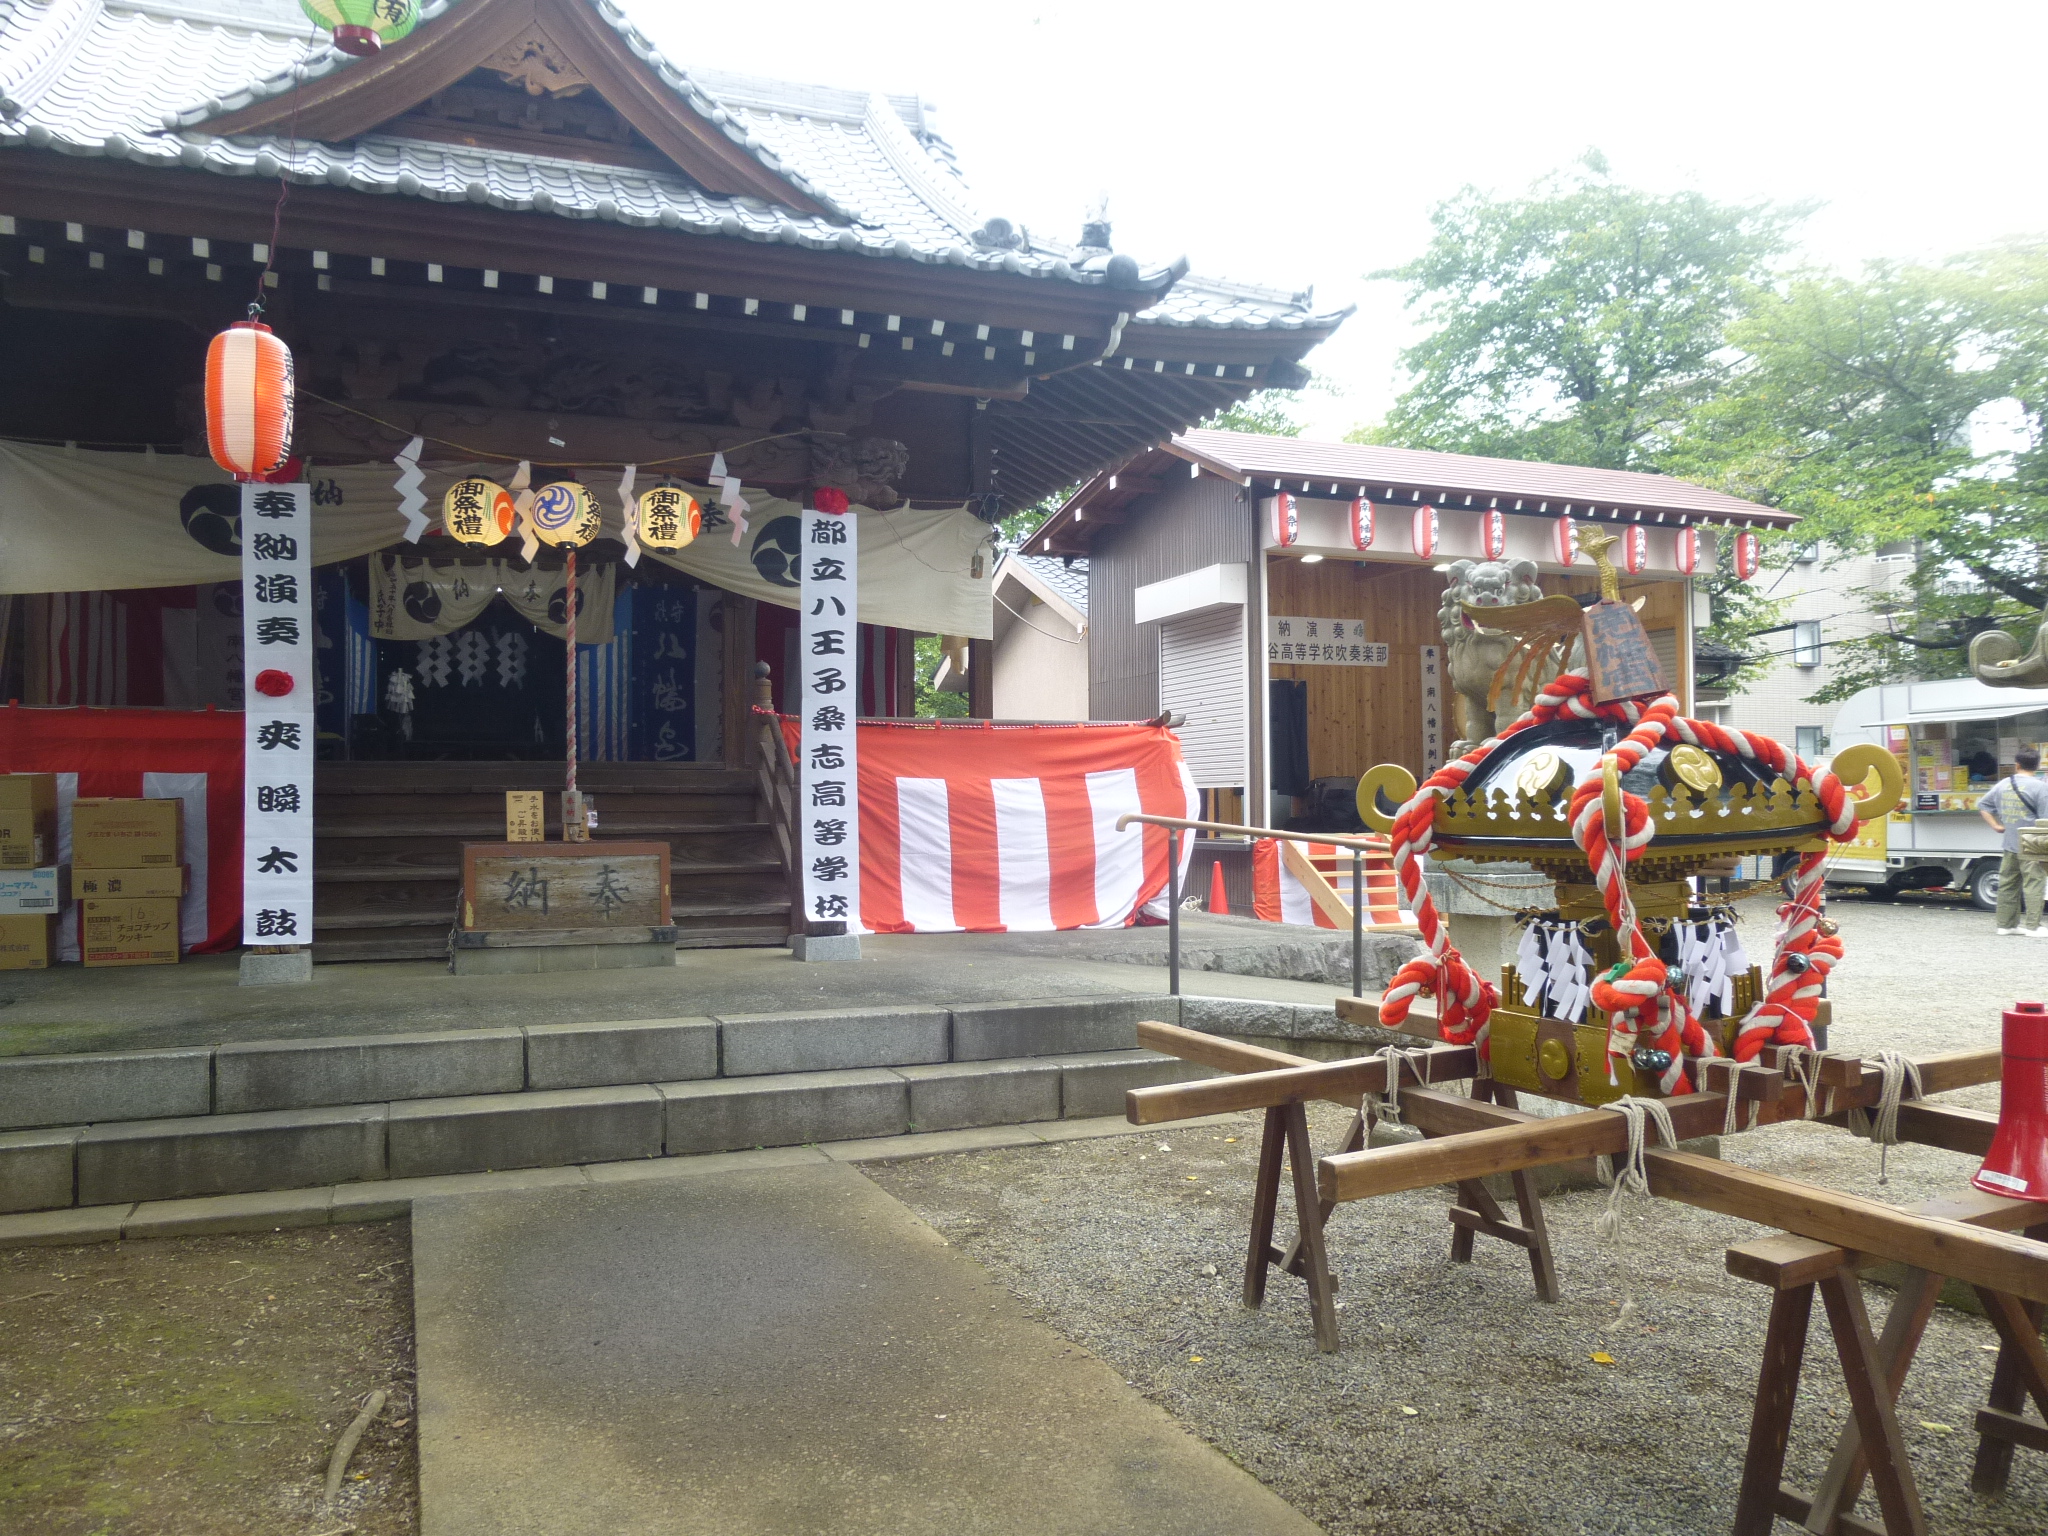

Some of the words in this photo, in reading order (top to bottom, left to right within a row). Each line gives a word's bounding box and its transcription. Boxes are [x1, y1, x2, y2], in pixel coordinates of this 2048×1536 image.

[450, 481, 485, 536] 御祭禮
[647, 490, 680, 541] 御祭禮
[1359, 502, 1371, 545] 南八幡宮
[1268, 642, 1387, 662] 谷高等学校吹奏楽部
[809, 519, 849, 918] 都立八王子桑志高等学校
[1426, 687, 1437, 779] 南八幡宮例大
[117, 921, 171, 933] チョコチップ
[117, 933, 153, 942] クッキー
